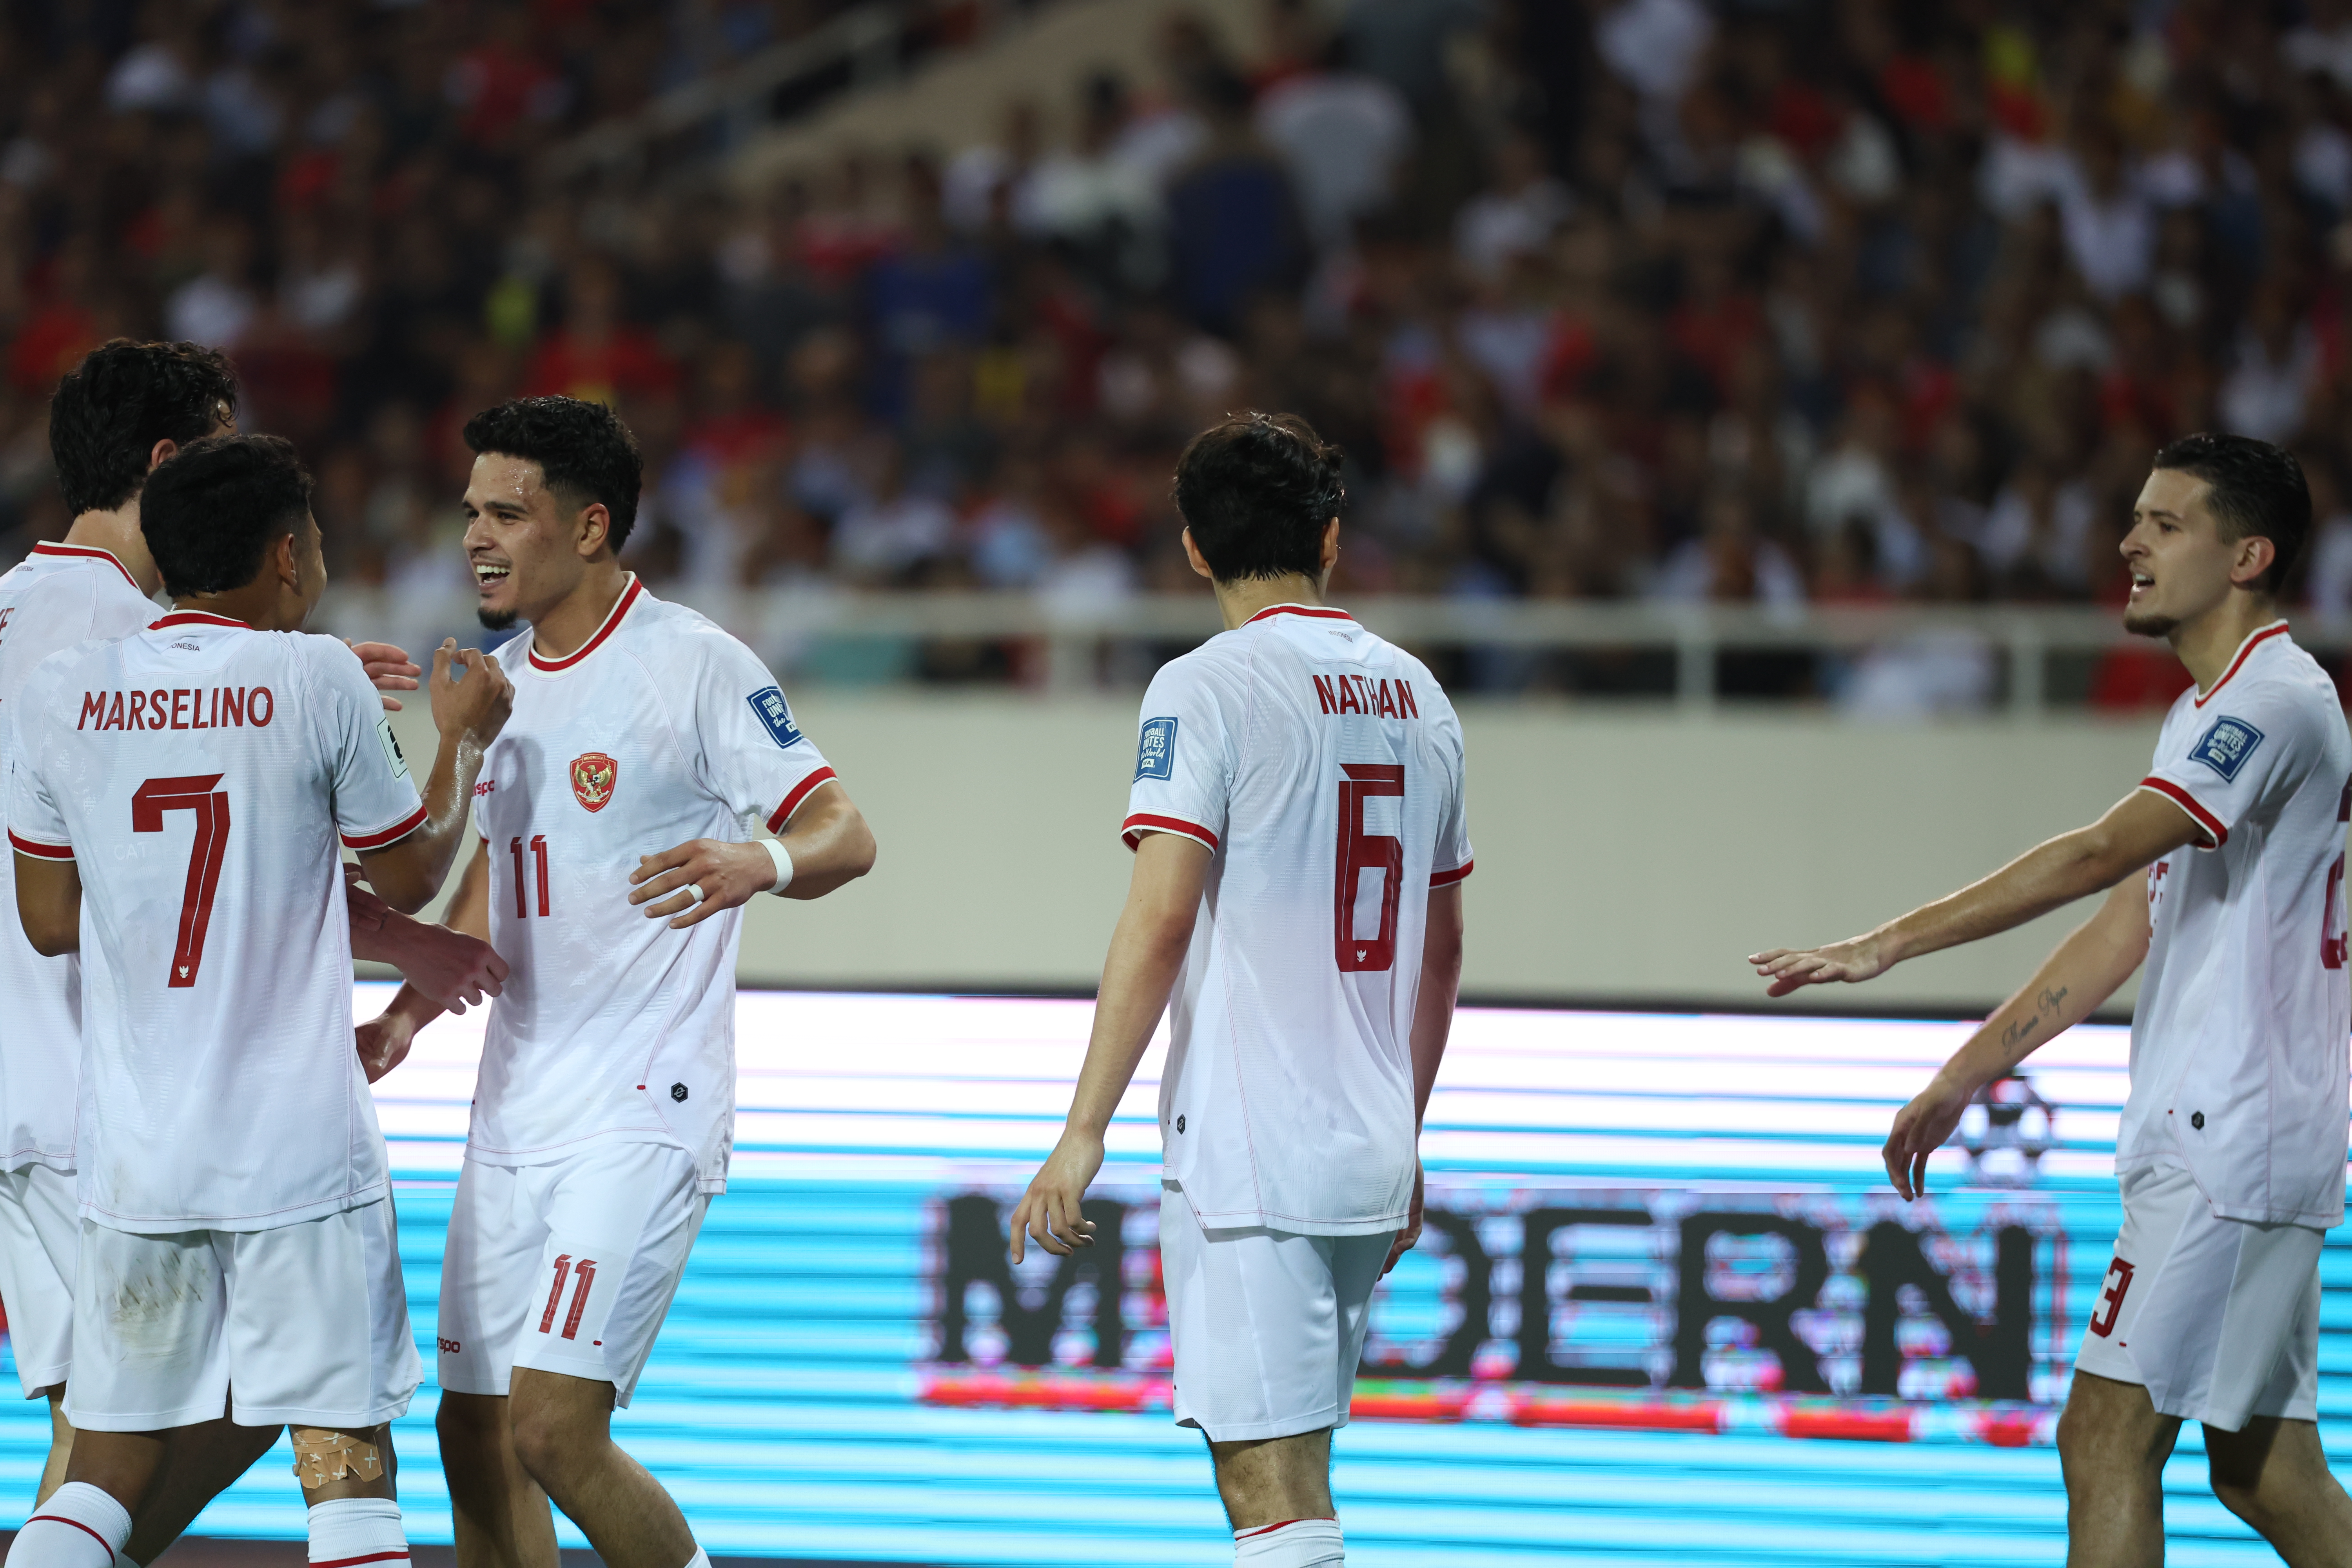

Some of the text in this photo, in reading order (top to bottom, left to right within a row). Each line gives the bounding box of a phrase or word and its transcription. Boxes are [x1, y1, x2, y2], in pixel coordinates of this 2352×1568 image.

[171, 642, 200, 652] ONESIA
[1328, 630, 1353, 643] INDONESIA
[77, 686, 274, 731] MARSELINO
[1312, 674, 1419, 720] NATHAN
[1143, 736, 1165, 750] UNITES
[1144, 728, 1165, 739] FOOTBALL
[1145, 748, 1165, 759] World
[132, 773, 230, 987] 7
[510, 835, 550, 918] 11
[1334, 763, 1405, 972] 6
[538, 1254, 597, 1341] 11
[940, 1194, 2034, 1401] MDERN
